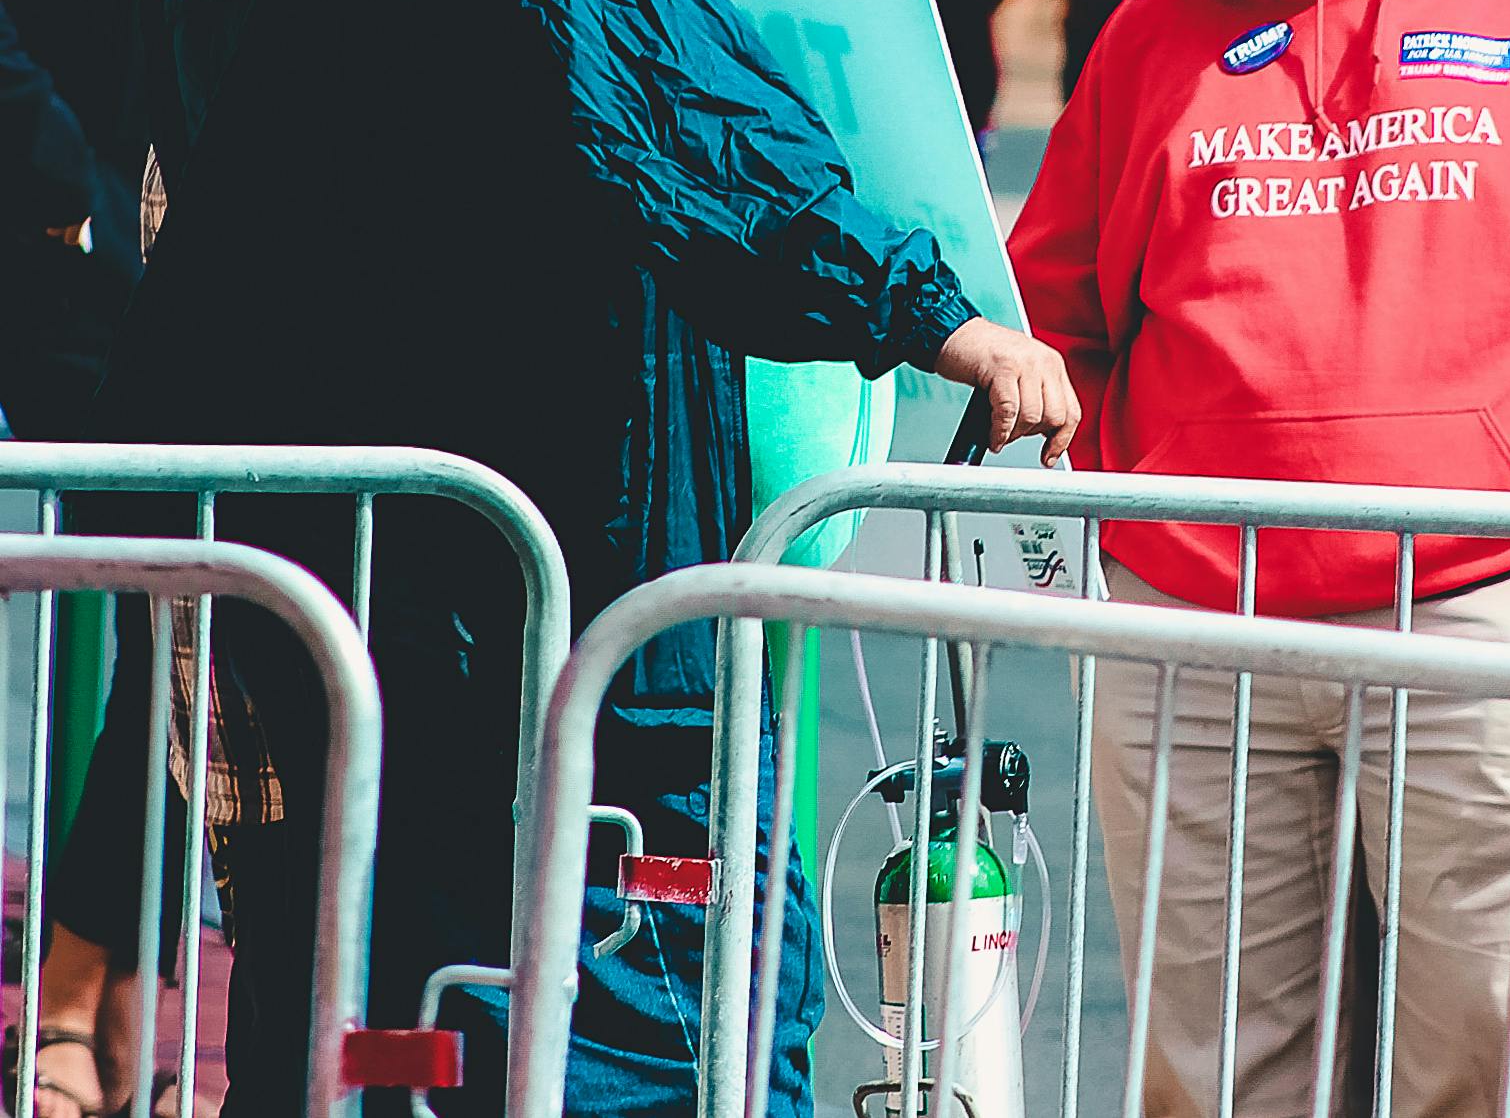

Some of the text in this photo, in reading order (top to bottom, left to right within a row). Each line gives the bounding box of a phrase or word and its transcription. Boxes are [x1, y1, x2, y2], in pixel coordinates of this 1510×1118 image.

[1223, 22, 1288, 65] TRUMP
[1188, 106, 1502, 168] MAKE AMERICA
[1210, 161, 1479, 219] GREAT AGAIN
